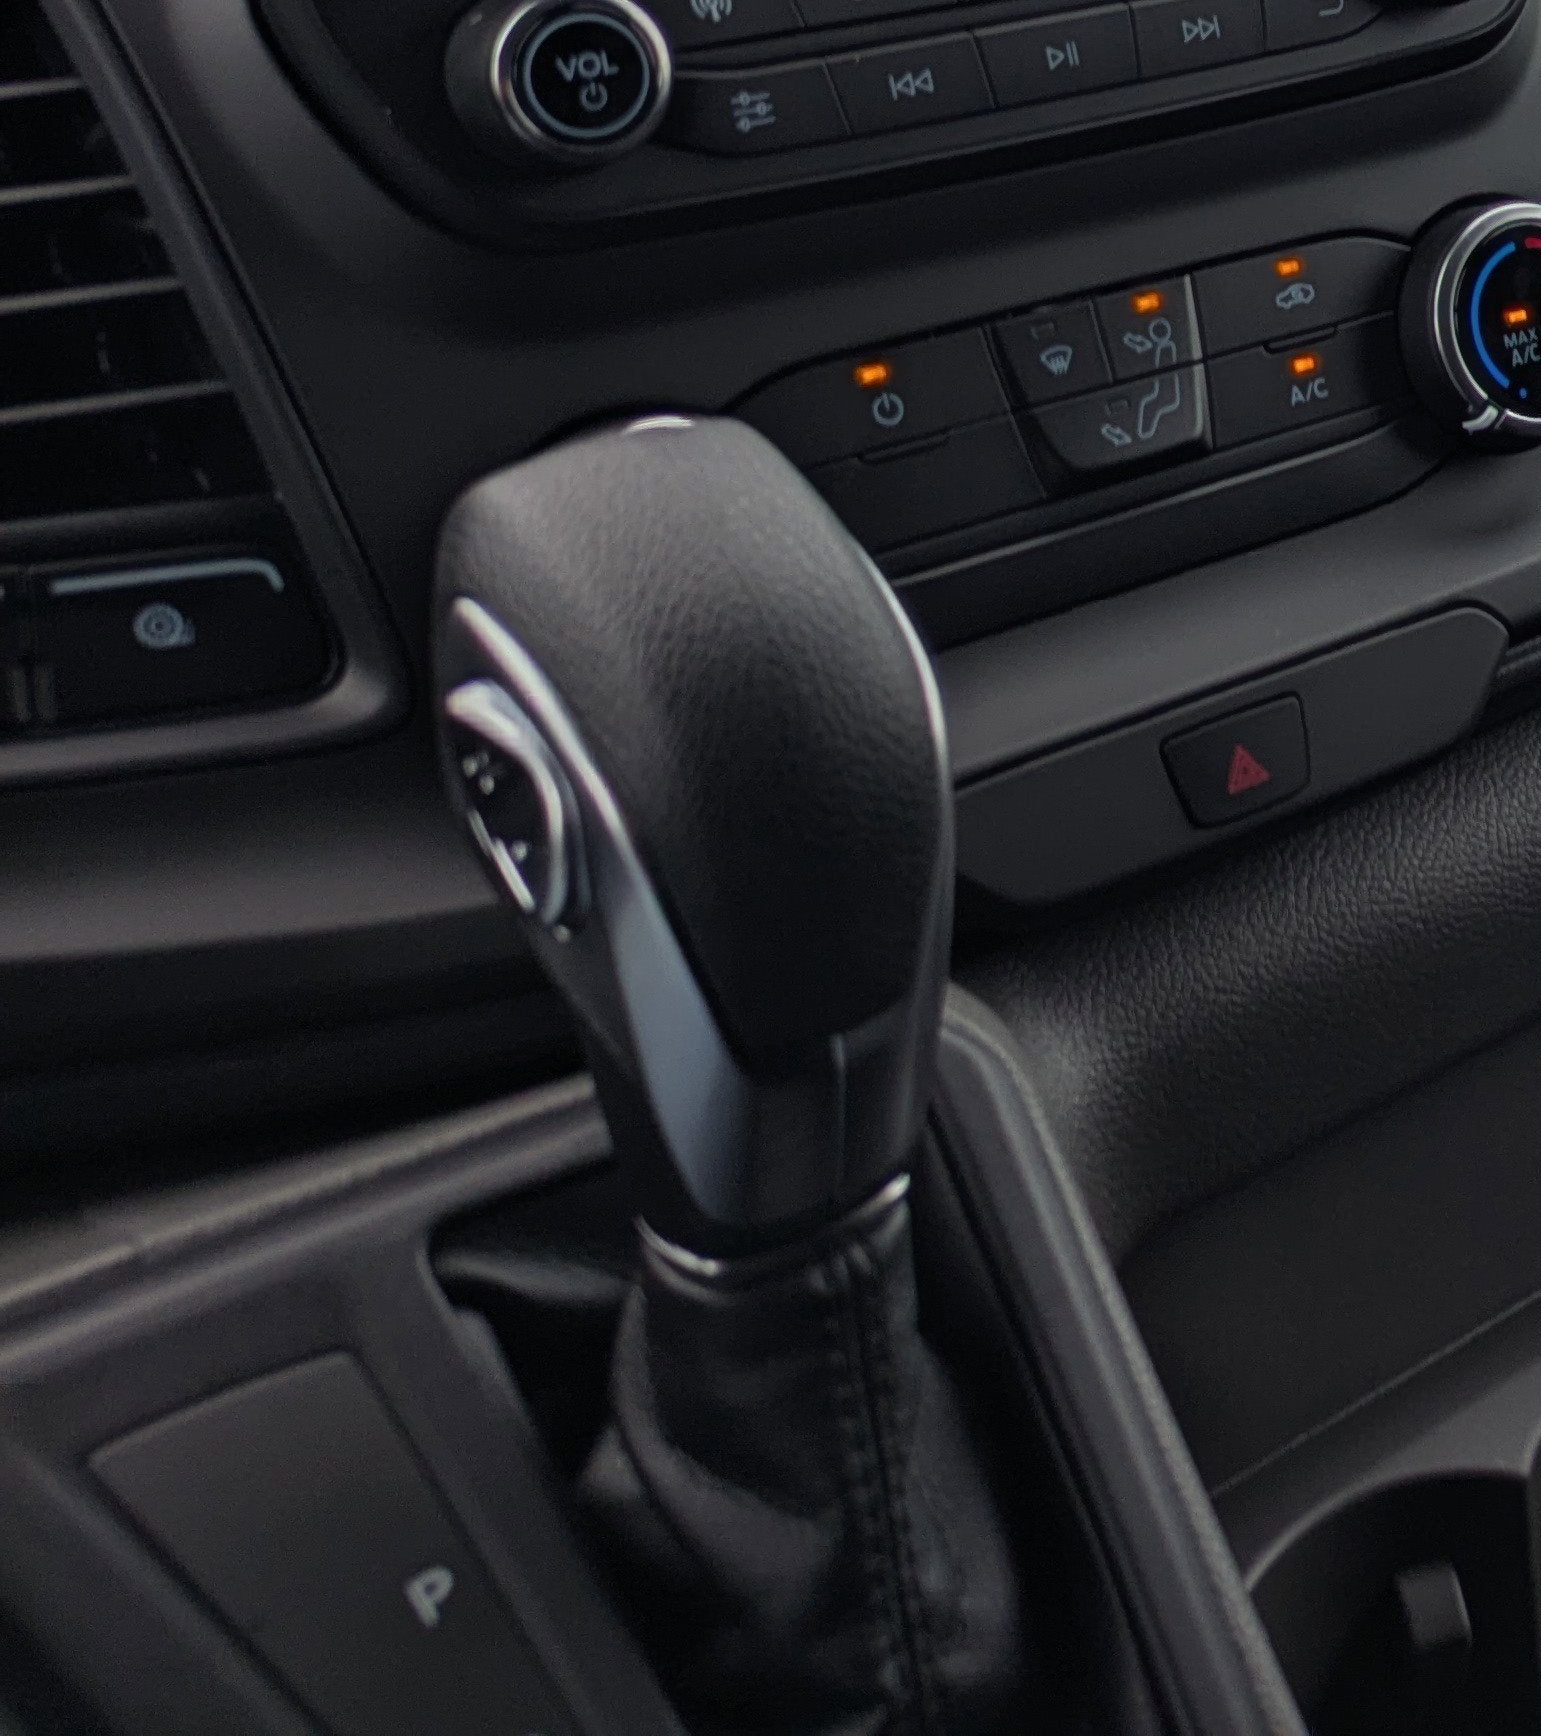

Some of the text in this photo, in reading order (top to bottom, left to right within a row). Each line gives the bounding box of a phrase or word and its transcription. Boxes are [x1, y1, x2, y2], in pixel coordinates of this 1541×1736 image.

[554, 48, 621, 83] VOL
[1502, 325, 1540, 350] MAX
[1511, 342, 1541, 368] A/C
[1290, 375, 1330, 408] A/C
[405, 1565, 454, 1627] P
